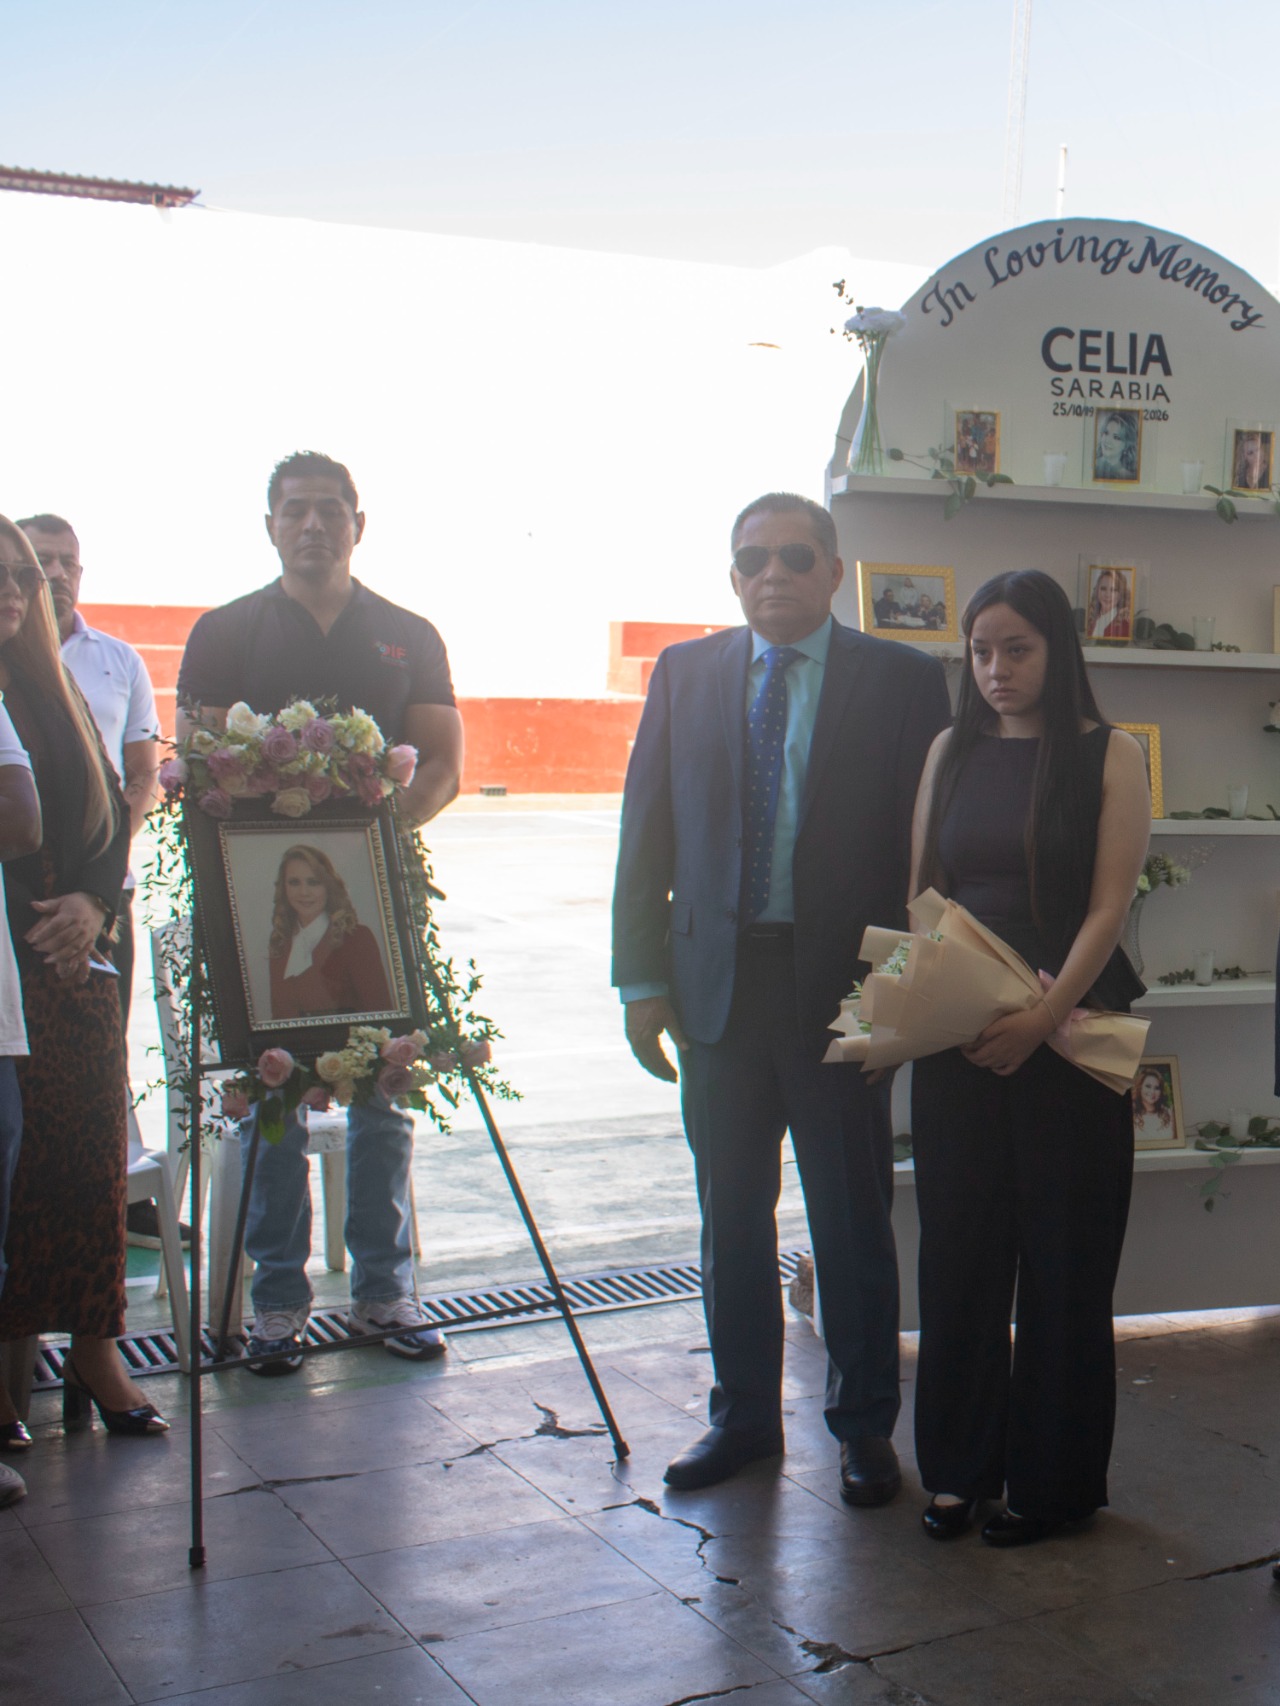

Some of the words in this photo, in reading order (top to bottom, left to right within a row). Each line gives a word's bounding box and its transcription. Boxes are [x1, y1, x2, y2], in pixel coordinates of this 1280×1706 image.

[921, 281, 977, 327] In
[984, 228, 1133, 288] Loving
[1128, 235, 1266, 331] Memory
[1041, 327, 1173, 377] CELIA
[1050, 377, 1171, 403] SARABIA
